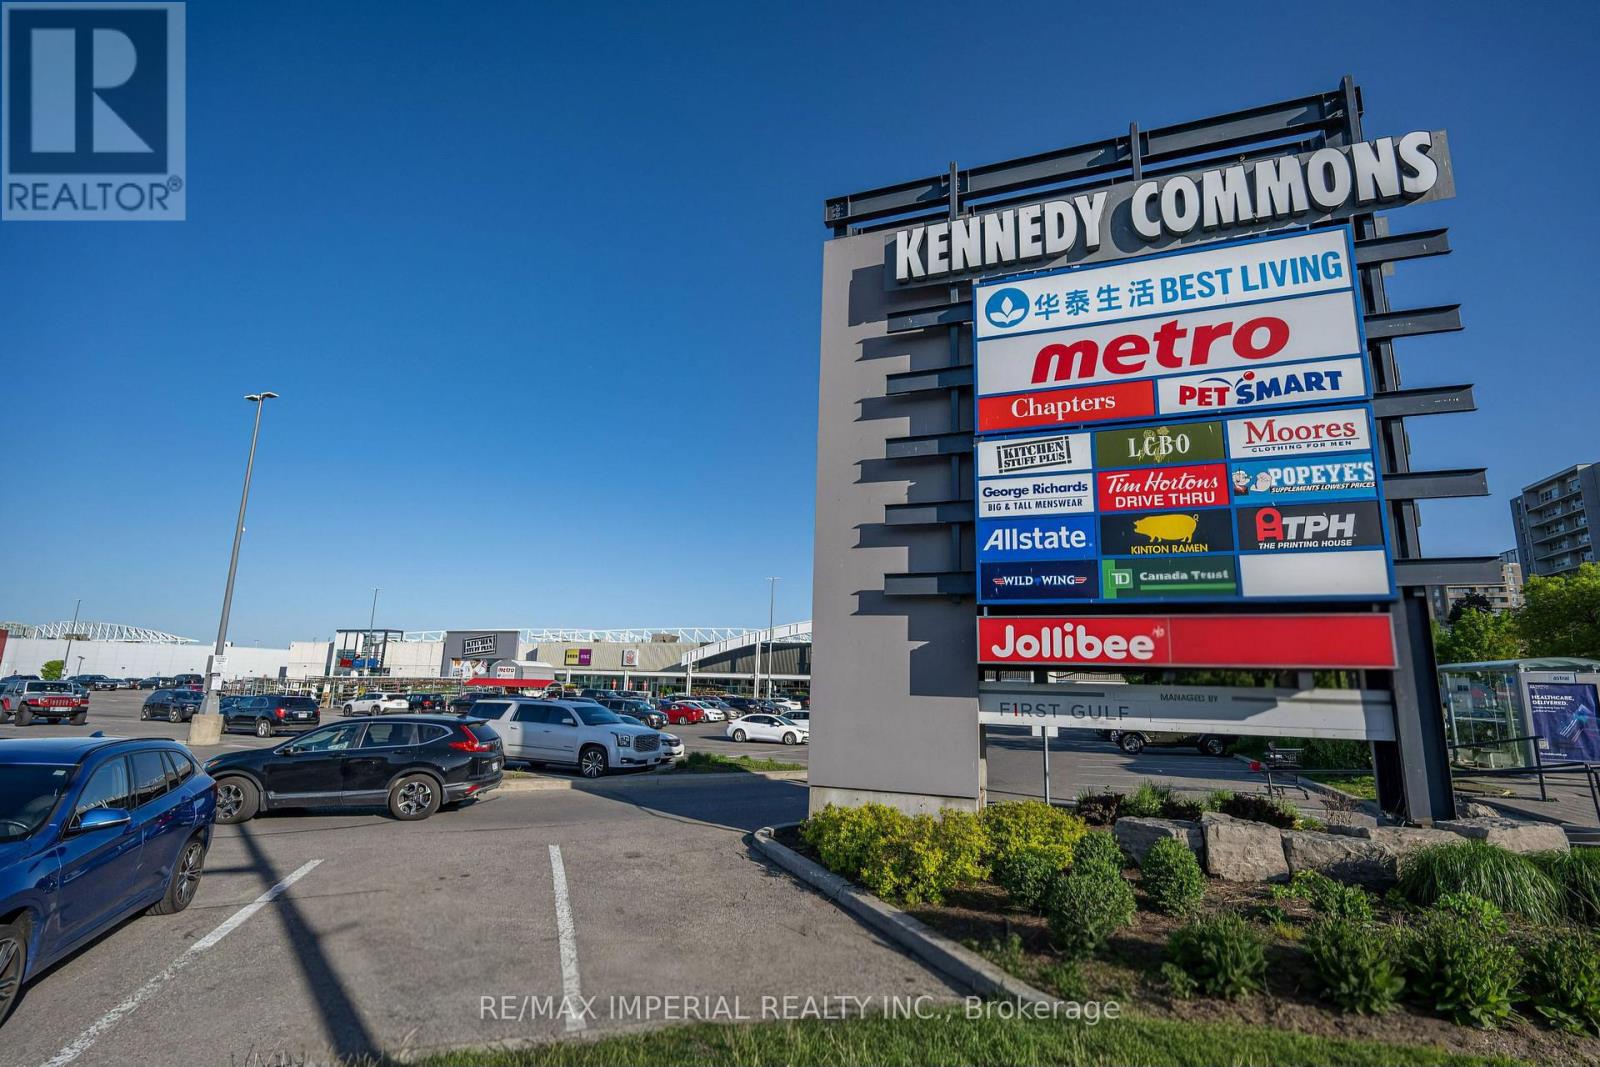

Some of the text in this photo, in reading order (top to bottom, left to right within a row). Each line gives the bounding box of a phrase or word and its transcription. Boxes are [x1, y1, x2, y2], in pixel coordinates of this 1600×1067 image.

[895, 131, 1438, 282] KENNEDY COMMONS
[1161, 251, 1343, 304] BEST LIVING
[1034, 278, 1156, 321] 华泰生活
[1031, 316, 1290, 384] metro
[1011, 394, 1116, 421] Chapters
[1243, 418, 1356, 445] Moores
[1003, 441, 1064, 459] KITCHEN
[1128, 433, 1190, 458] LCBO
[1251, 444, 1303, 453] CLOTHING
[1003, 452, 1066, 468] STUFF PLUS
[1106, 471, 1218, 494] Tim Hortons
[1268, 461, 1375, 487] POPEYE'S
[982, 481, 1088, 499] George Richards
[1271, 484, 1320, 493] SUPPLEMENTS
[1321, 482, 1350, 490] LOWEST
[988, 503, 1001, 511] BIG
[1014, 501, 1032, 510] TALL
[1035, 498, 1083, 509] MENSWEAR
[1115, 491, 1215, 508] DRIVE THRU
[983, 525, 1086, 551] Allstate
[1258, 539, 1353, 550] THE PRINTING HOUSE
[1130, 543, 1208, 555] KINTON RAMEN
[1003, 575, 1075, 585] WILD WING
[1111, 572, 1130, 585] TD
[1140, 570, 1229, 581] Canada Trust
[991, 622, 1155, 660] Jollibee
[1160, 693, 1218, 703] MANAGED BY
[1000, 702, 1129, 721] FIRST GULF
